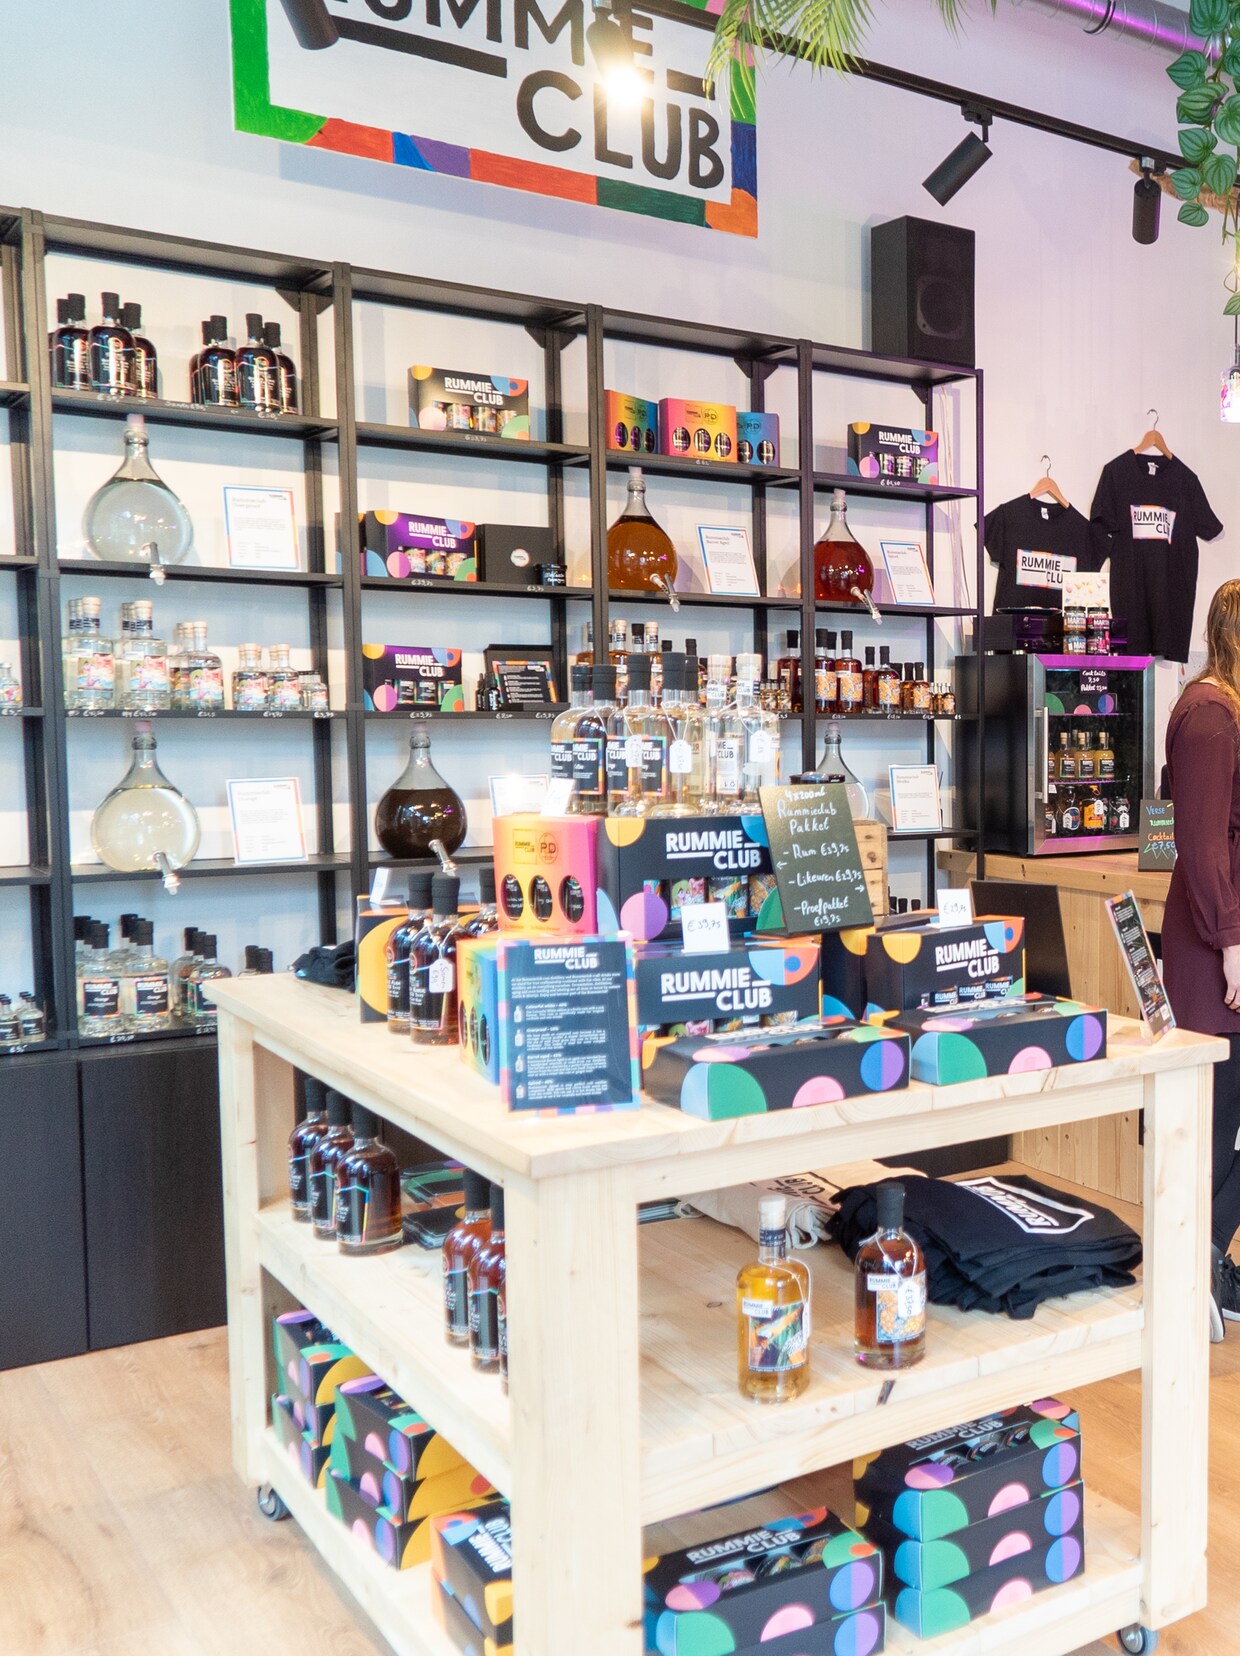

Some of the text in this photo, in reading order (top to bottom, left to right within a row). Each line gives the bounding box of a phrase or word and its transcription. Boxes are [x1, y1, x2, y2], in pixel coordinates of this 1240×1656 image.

[516, 68, 725, 190] CLUB
[444, 377, 492, 393] RUMMIE
[473, 392, 504, 406] CLUB
[878, 431, 913, 445] RUMMIE
[899, 443, 921, 455] CLUB
[1133, 510, 1168, 523] RUMMIE
[408, 521, 447, 536] RUMMIE
[1155, 524, 1171, 536] CLU
[432, 536, 457, 549] CLUB
[1021, 556, 1062, 572] RUMMIE
[1047, 571, 1063, 585] CLU
[394, 653, 434, 666] RUMMIE
[418, 666, 444, 678] CLUB
[554, 753, 573, 762] CLUB
[577, 752, 596, 761] CLUB
[789, 816, 830, 836] Pakket
[666, 830, 744, 852] RUMMIE
[792, 843, 817, 860] Rum
[713, 850, 761, 870] CLUB
[534, 946, 586, 960] RUMMIE
[935, 938, 989, 966] RUMMIE
[564, 958, 599, 970] CLUB
[967, 957, 1000, 979] CLUB
[661, 967, 750, 994] RUMMIE
[716, 987, 773, 1012] CLUB
[905, 1420, 978, 1449] RUMMIE
[958, 1419, 1004, 1439] CLUB
[685, 1529, 774, 1564] RUMMIE
[746, 1529, 802, 1556] CLUB
